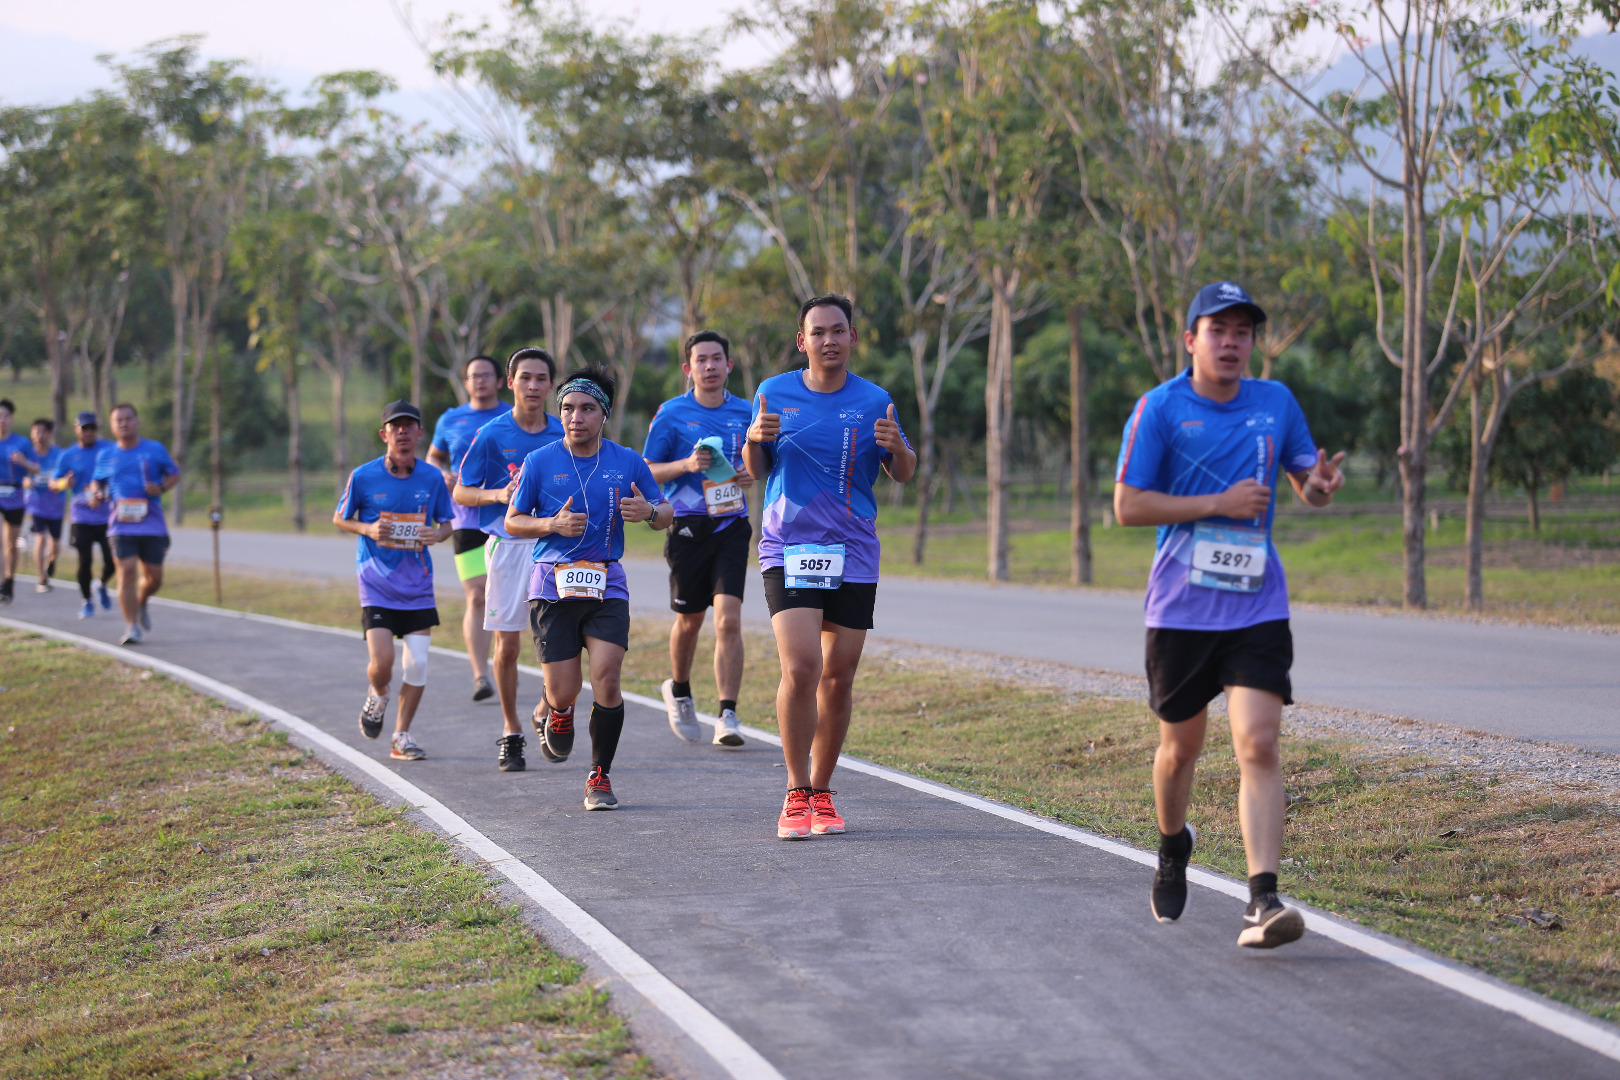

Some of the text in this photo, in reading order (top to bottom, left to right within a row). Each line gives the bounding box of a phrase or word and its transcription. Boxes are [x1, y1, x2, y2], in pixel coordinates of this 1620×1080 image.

[842, 427, 850, 450] CROSS
[799, 559, 832, 571] 5057
[1210, 550, 1252, 568] 5297
[566, 571, 601, 585] 8009
